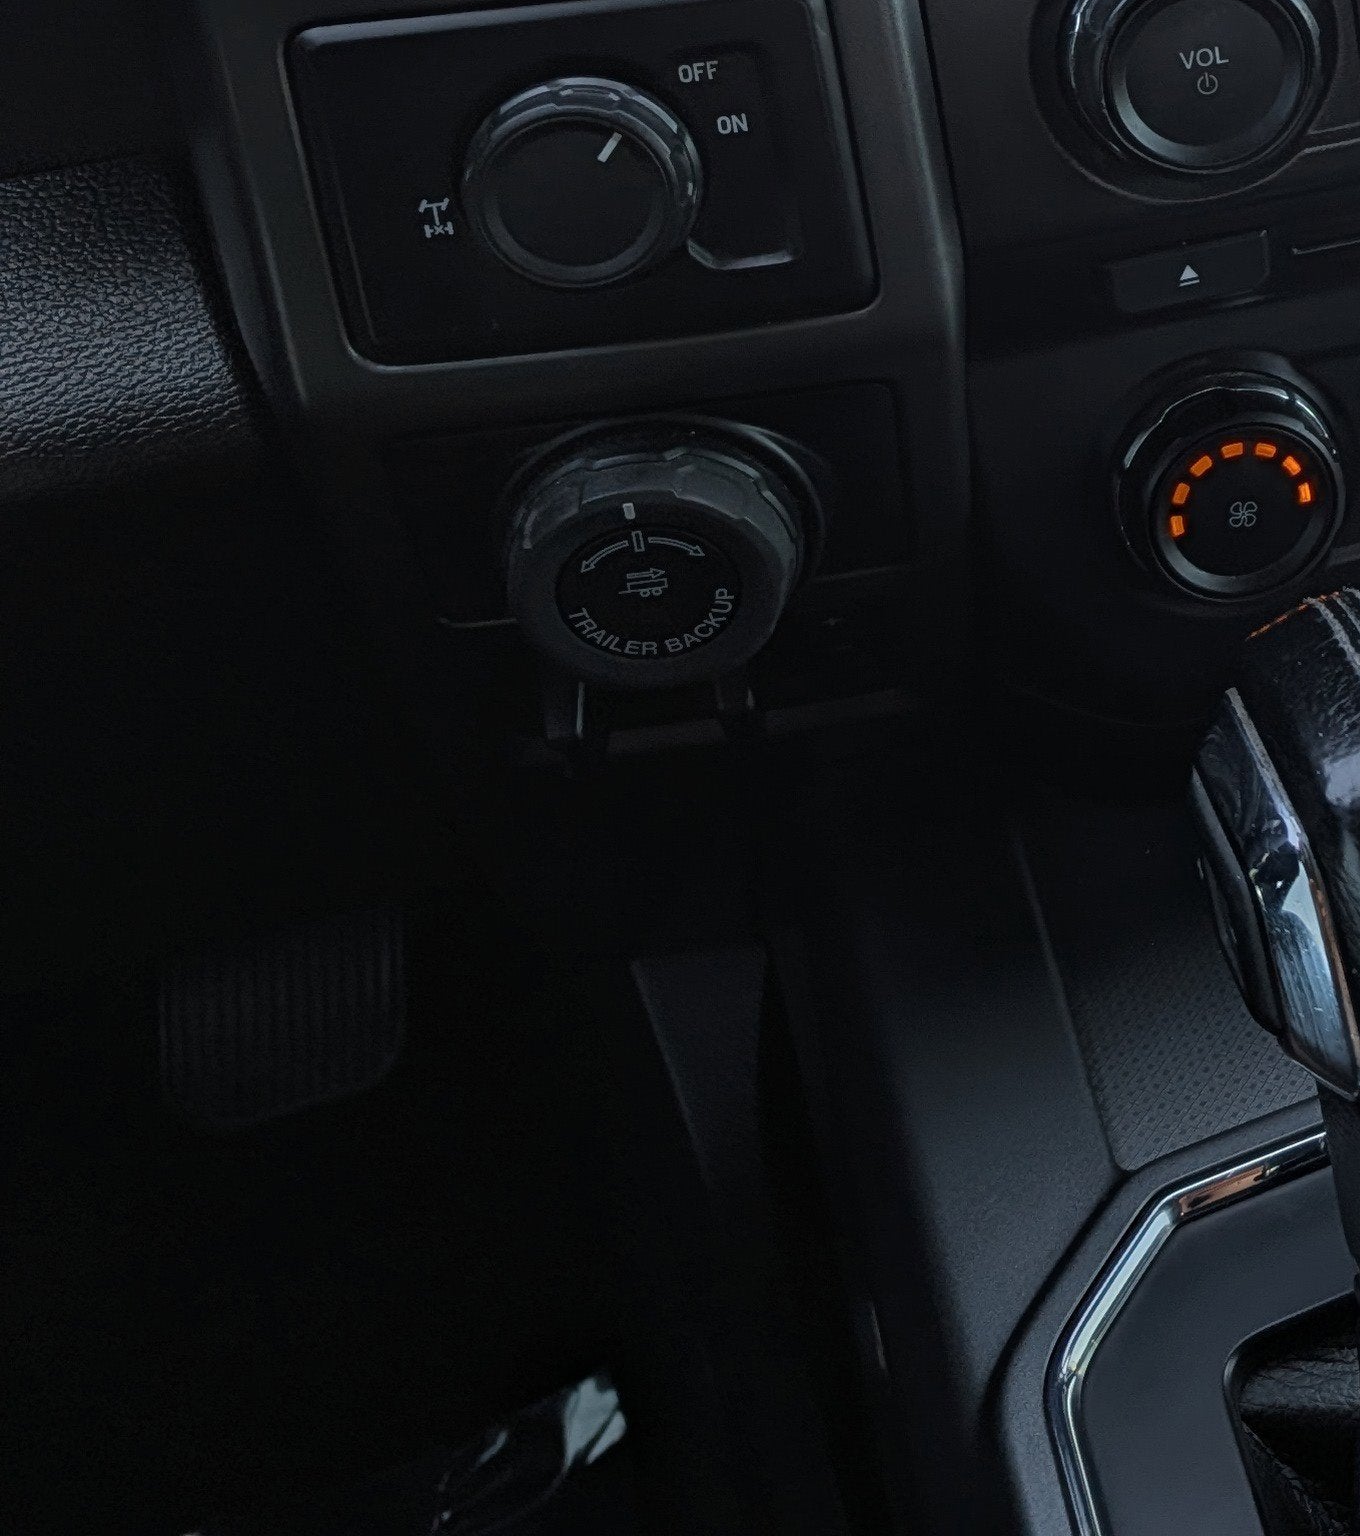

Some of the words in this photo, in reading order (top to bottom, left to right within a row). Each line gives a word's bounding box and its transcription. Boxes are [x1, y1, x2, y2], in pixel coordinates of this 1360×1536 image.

[1179, 46, 1230, 70] VOL
[678, 60, 719, 83] OFF
[716, 112, 749, 135] ON
[568, 607, 658, 656] TRAILER
[663, 587, 735, 653] BACKUP
